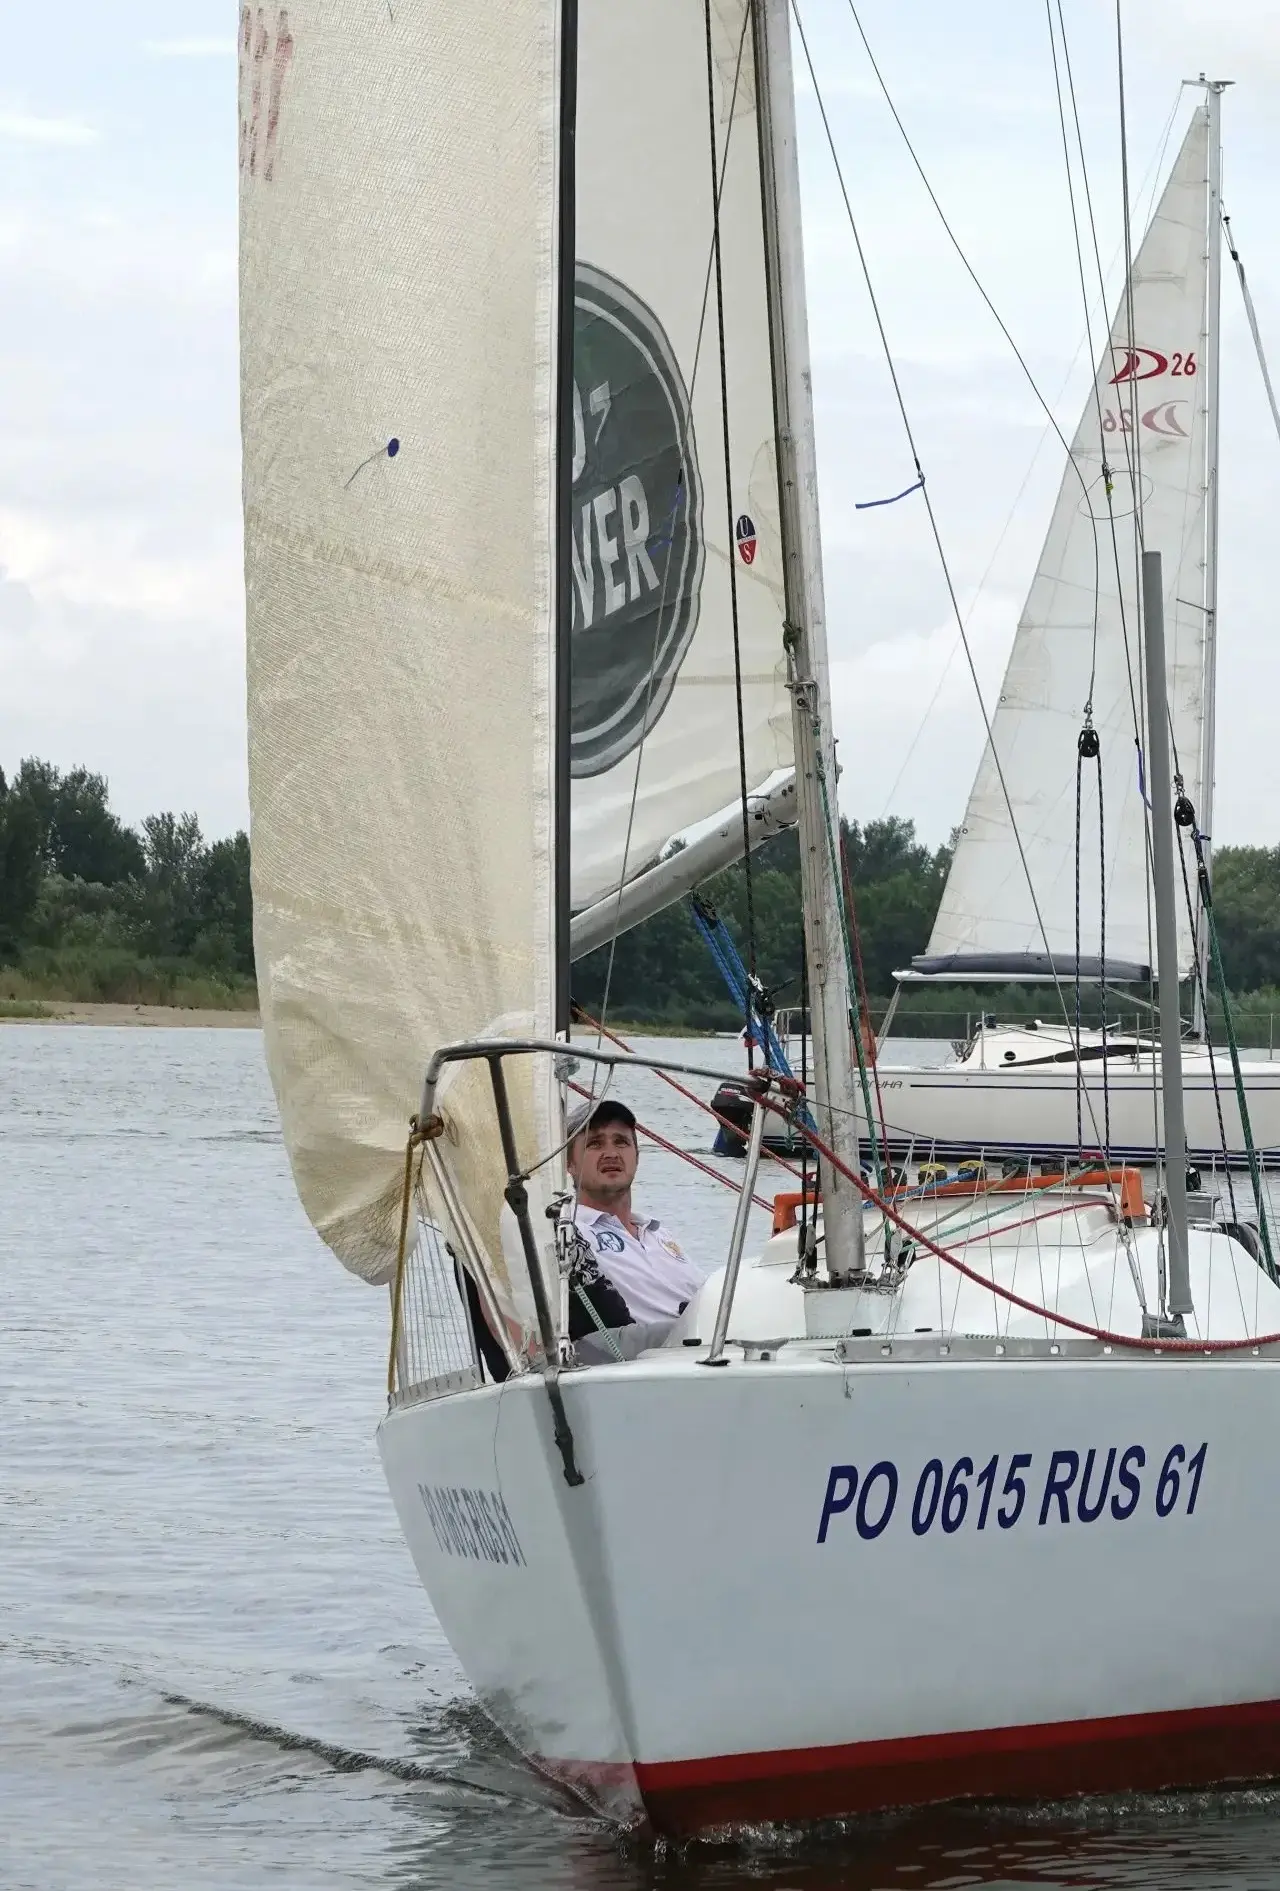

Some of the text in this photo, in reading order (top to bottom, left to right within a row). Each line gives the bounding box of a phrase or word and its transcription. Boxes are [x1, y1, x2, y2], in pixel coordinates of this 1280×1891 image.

[1171, 352, 1196, 376] 26
[572, 474, 661, 630] VER
[911, 1453, 1033, 1536] 0615
[1038, 1444, 1146, 1526] RUS
[1155, 1442, 1209, 1518] 61
